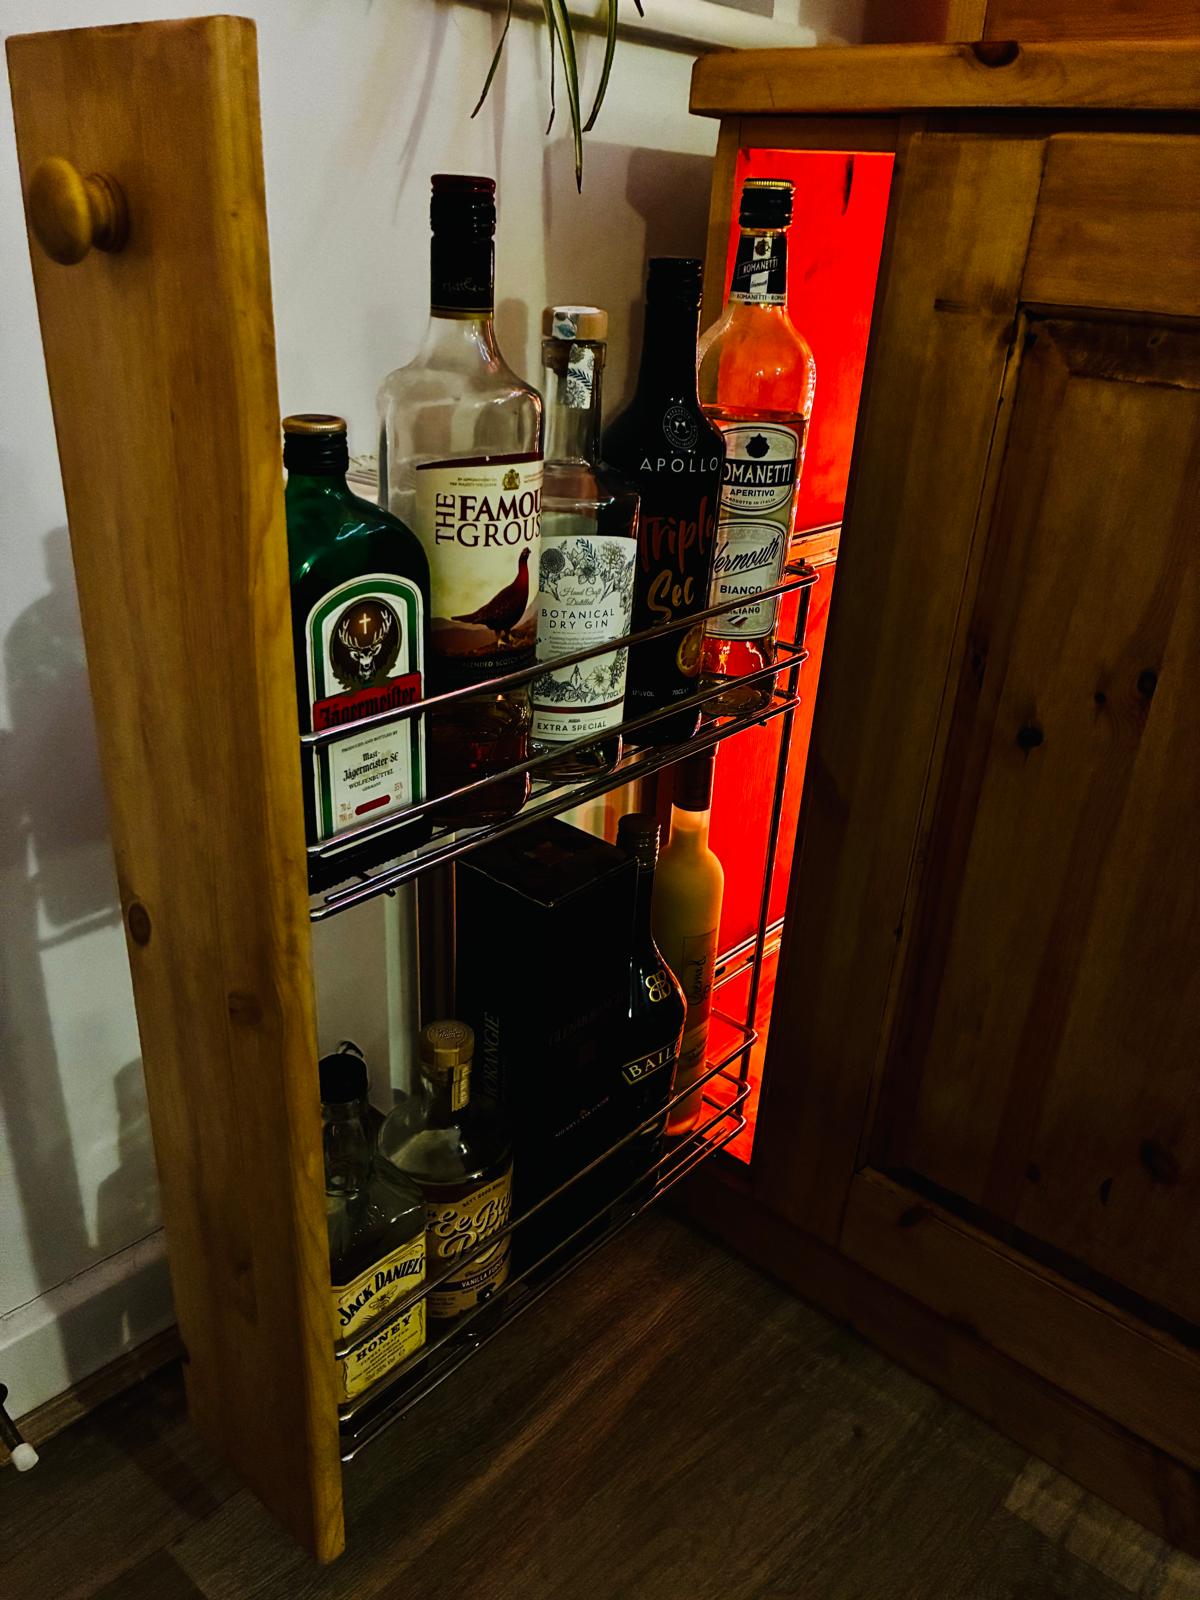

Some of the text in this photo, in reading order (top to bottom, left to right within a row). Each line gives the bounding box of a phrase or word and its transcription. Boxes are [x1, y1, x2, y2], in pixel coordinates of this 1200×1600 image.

[639, 456, 719, 473] APOLLO
[730, 488, 775, 497] APERITIVO
[435, 493, 455, 545] THE
[640, 494, 715, 575] Triple
[712, 534, 781, 574] Vermouth
[647, 568, 696, 624] Sec
[720, 584, 763, 595] BIANCO
[541, 608, 615, 619] BOTANICAL
[549, 619, 609, 630] DRY GIN
[536, 720, 607, 732] EXTRA SPECIAL
[337, 1283, 373, 1326] JACK
[374, 1252, 426, 1294] DANIEL'S
[356, 1314, 412, 1364] HONEY
